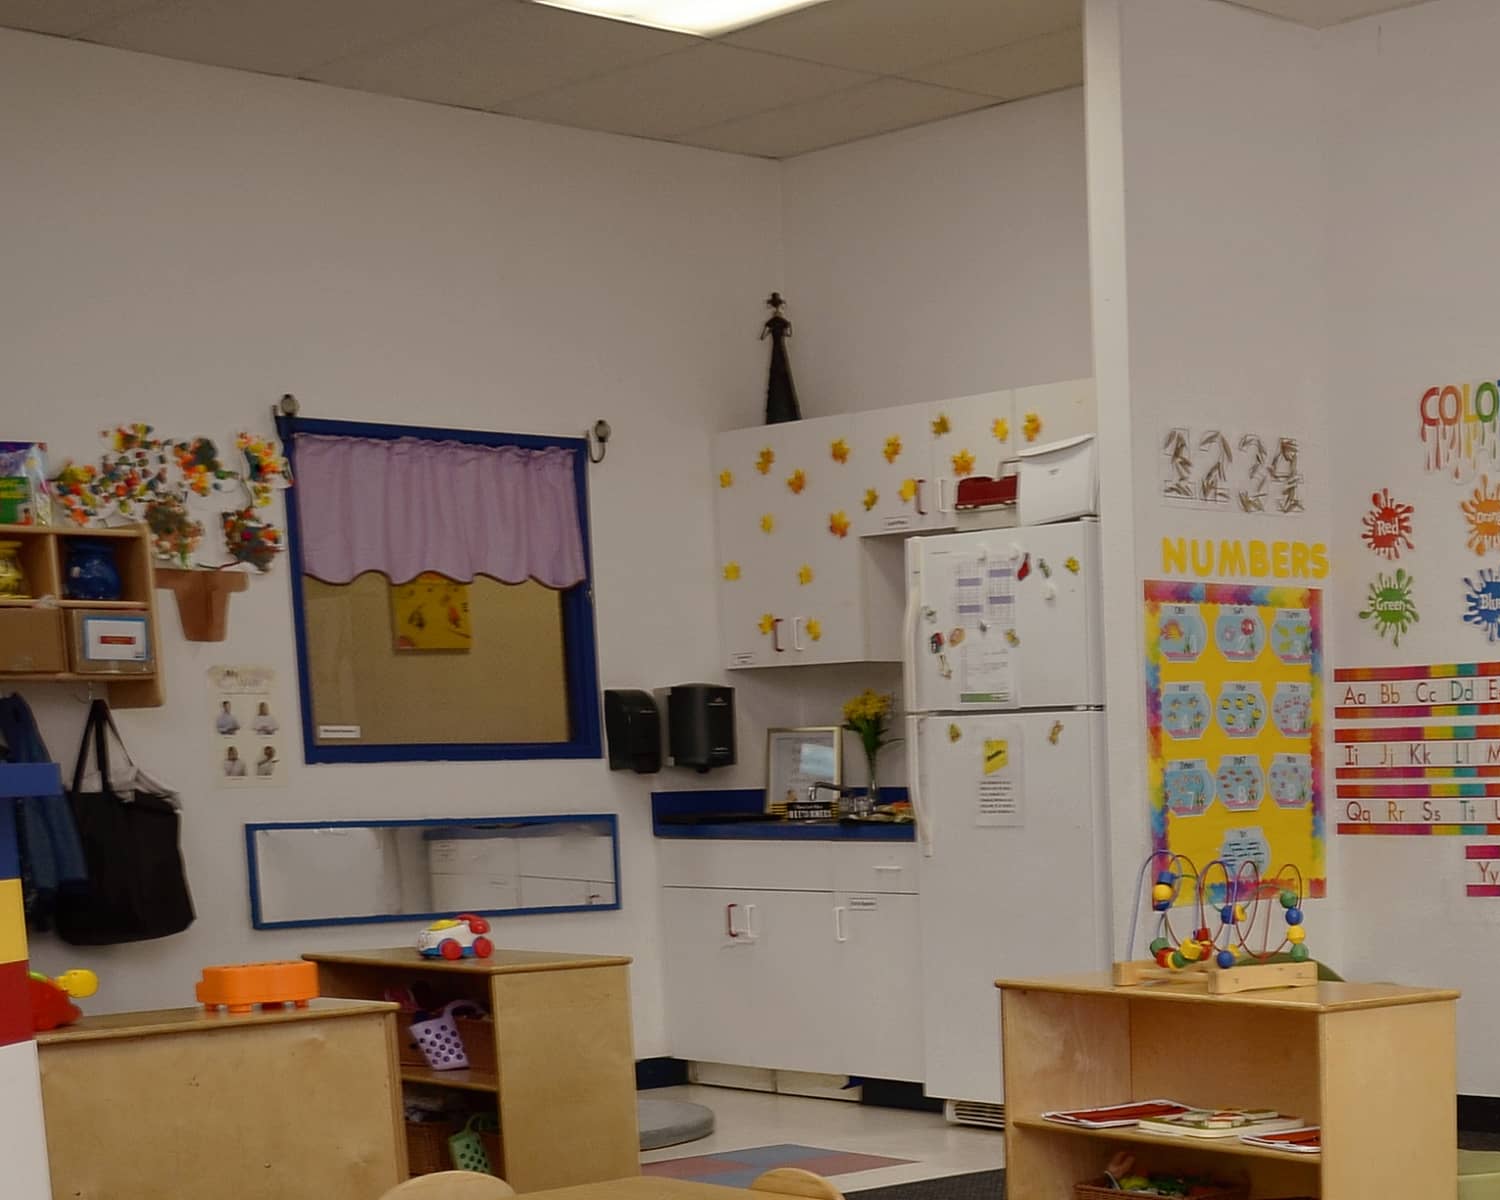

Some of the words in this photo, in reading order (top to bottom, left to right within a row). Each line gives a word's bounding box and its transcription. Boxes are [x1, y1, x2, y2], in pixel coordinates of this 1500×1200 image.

[1377, 520, 1398, 536] Red
[1162, 536, 1330, 580] NUMBERS
[1375, 598, 1406, 611] Green
[1344, 687, 1367, 705] Aa
[1380, 683, 1399, 705] Bb
[1416, 682, 1437, 703] Cc
[1451, 680, 1474, 701] Dd
[1345, 745, 1358, 766] Ii
[1380, 745, 1394, 769] Jj
[1409, 743, 1432, 765] Kk
[1455, 743, 1469, 764] Ll
[1346, 801, 1371, 823] Qq
[1387, 800, 1405, 822] Rr
[1423, 801, 1441, 821] Ss
[1459, 800, 1476, 821] Tt
[1478, 861, 1499, 884] Yy
